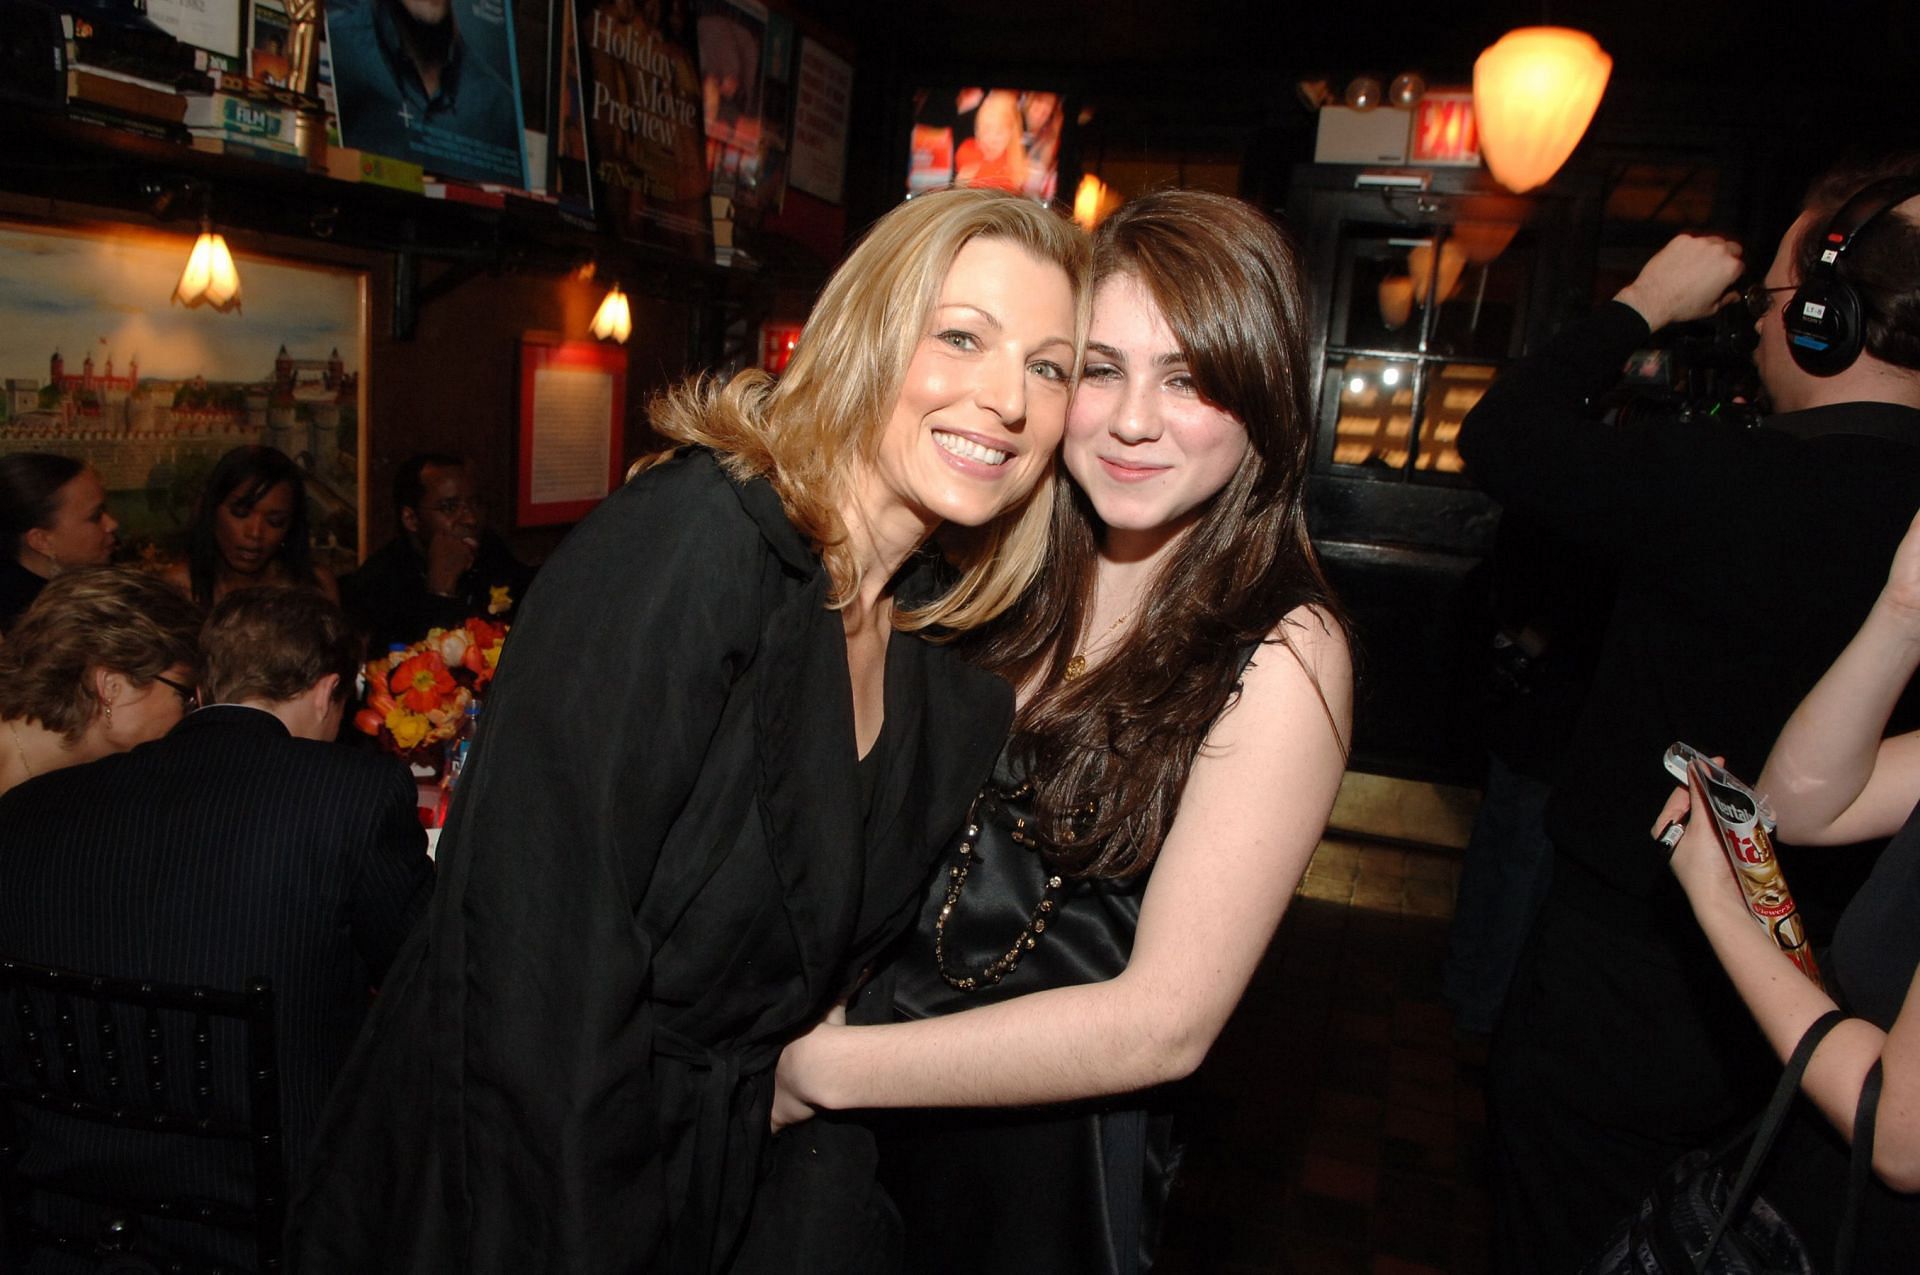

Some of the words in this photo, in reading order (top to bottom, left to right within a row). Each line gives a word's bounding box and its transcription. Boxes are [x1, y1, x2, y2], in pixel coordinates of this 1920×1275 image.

[592, 9, 675, 80] Holiday
[237, 109, 265, 127] FILM
[593, 82, 675, 145] Preview
[636, 71, 697, 127] Movie
